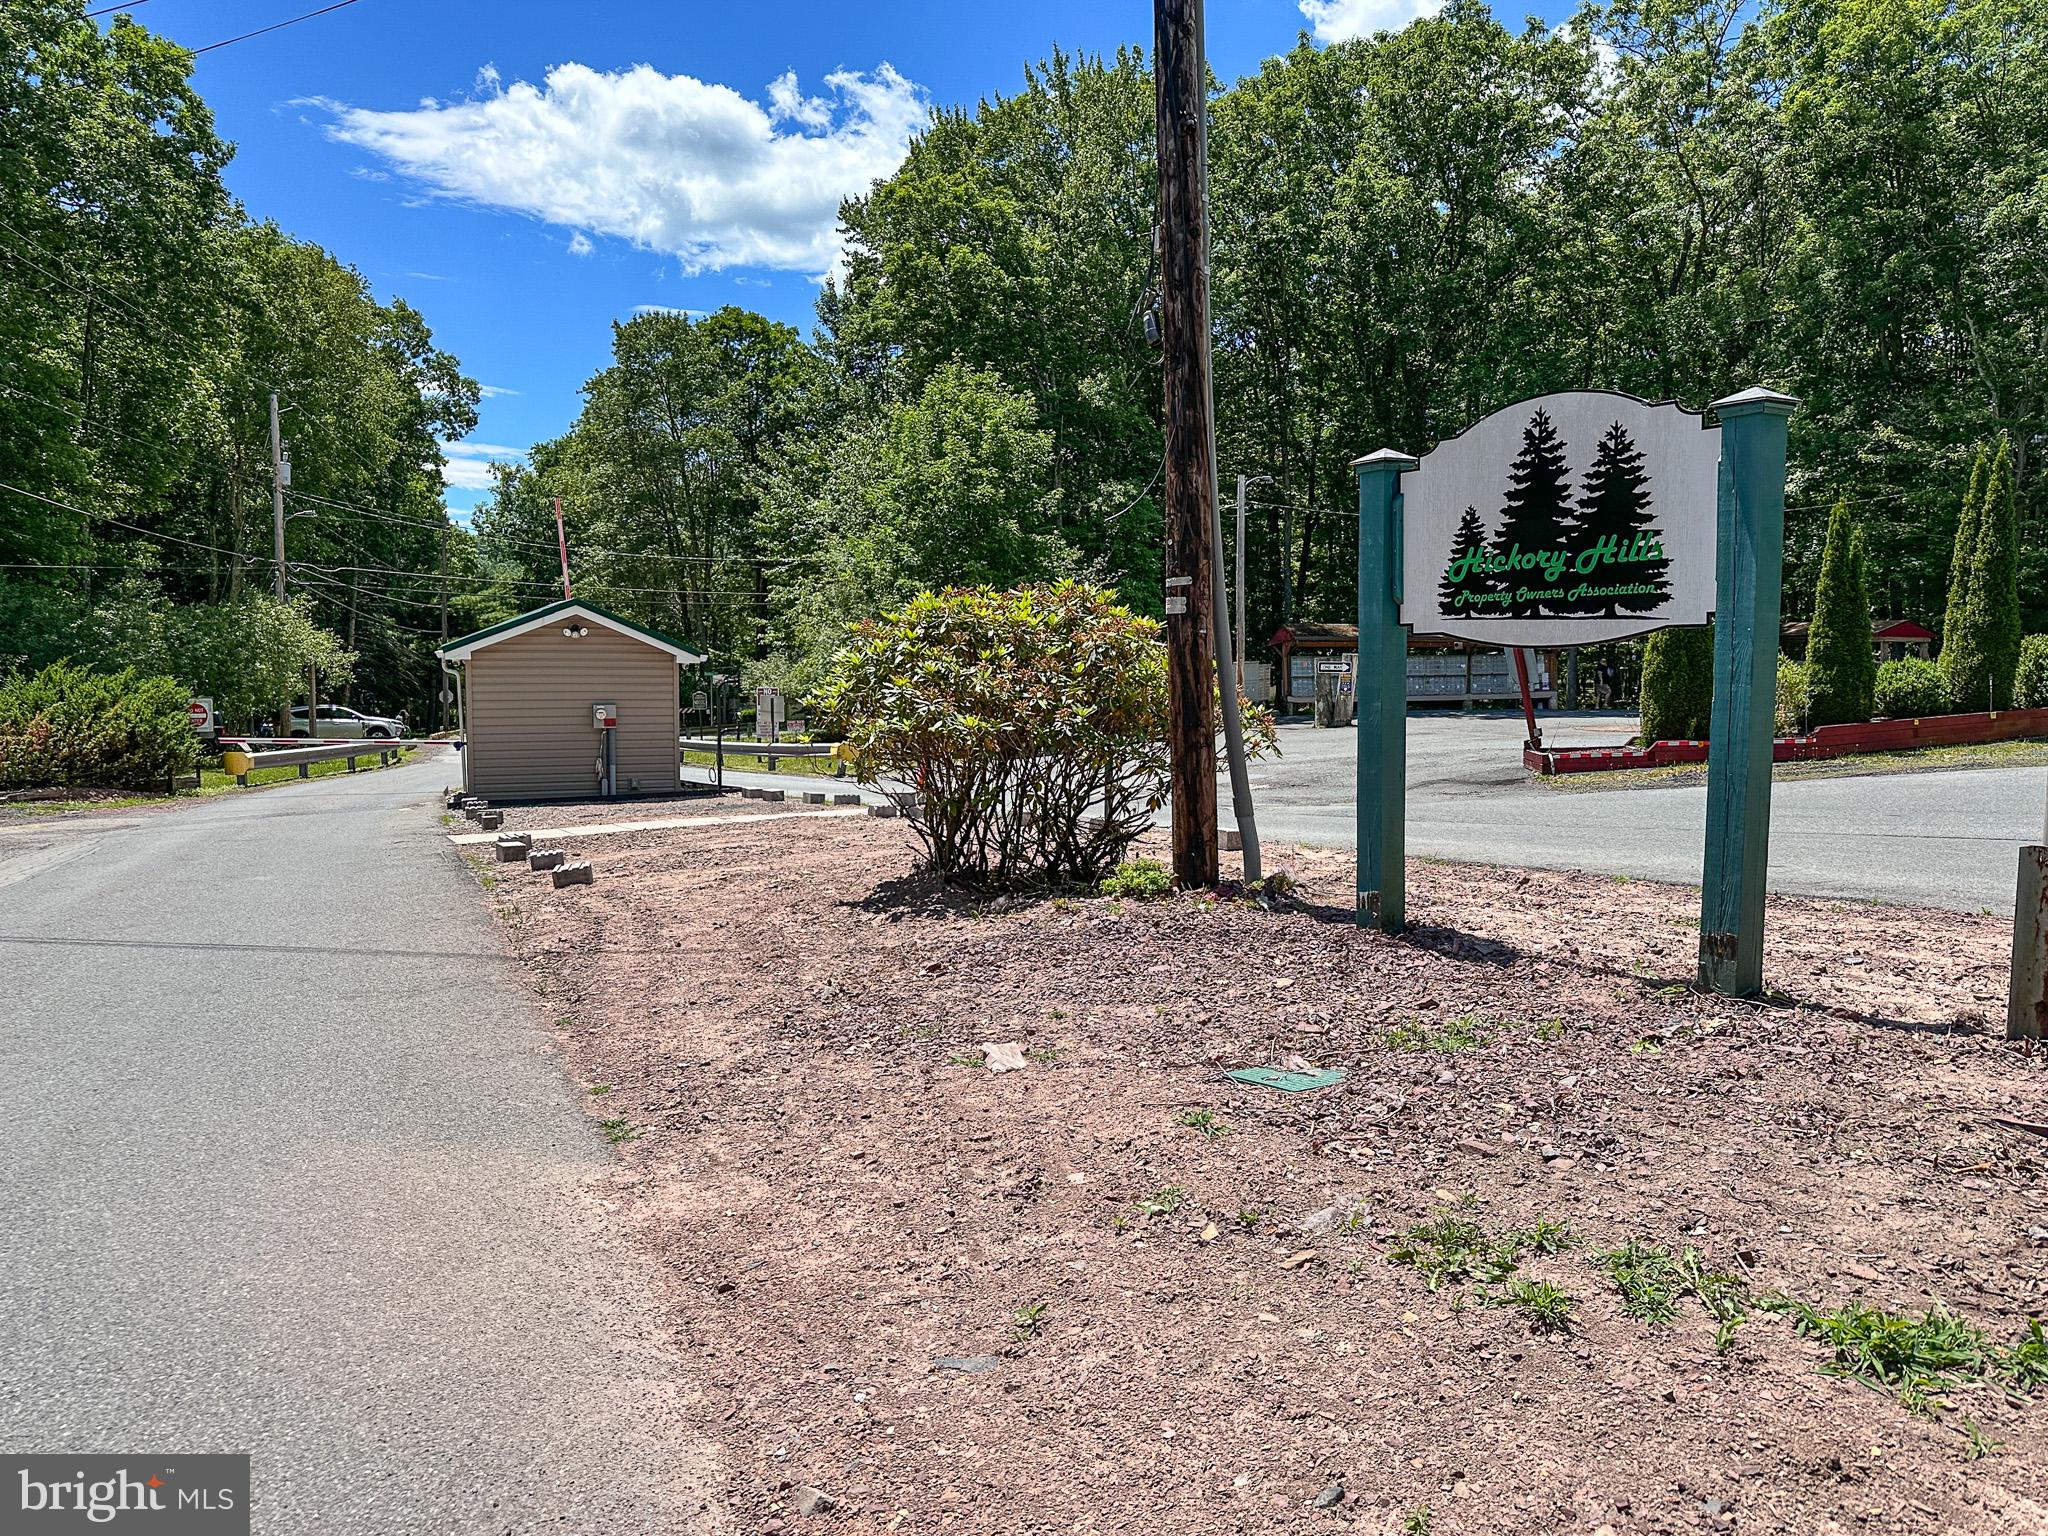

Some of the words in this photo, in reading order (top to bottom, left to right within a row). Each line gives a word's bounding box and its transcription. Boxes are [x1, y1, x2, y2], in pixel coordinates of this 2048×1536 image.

[1449, 543, 1567, 582] Hickory
[1575, 531, 1664, 574] Hills
[1454, 590, 1512, 608] Property
[1515, 587, 1565, 602] Owners
[1567, 583, 1655, 601] Association
